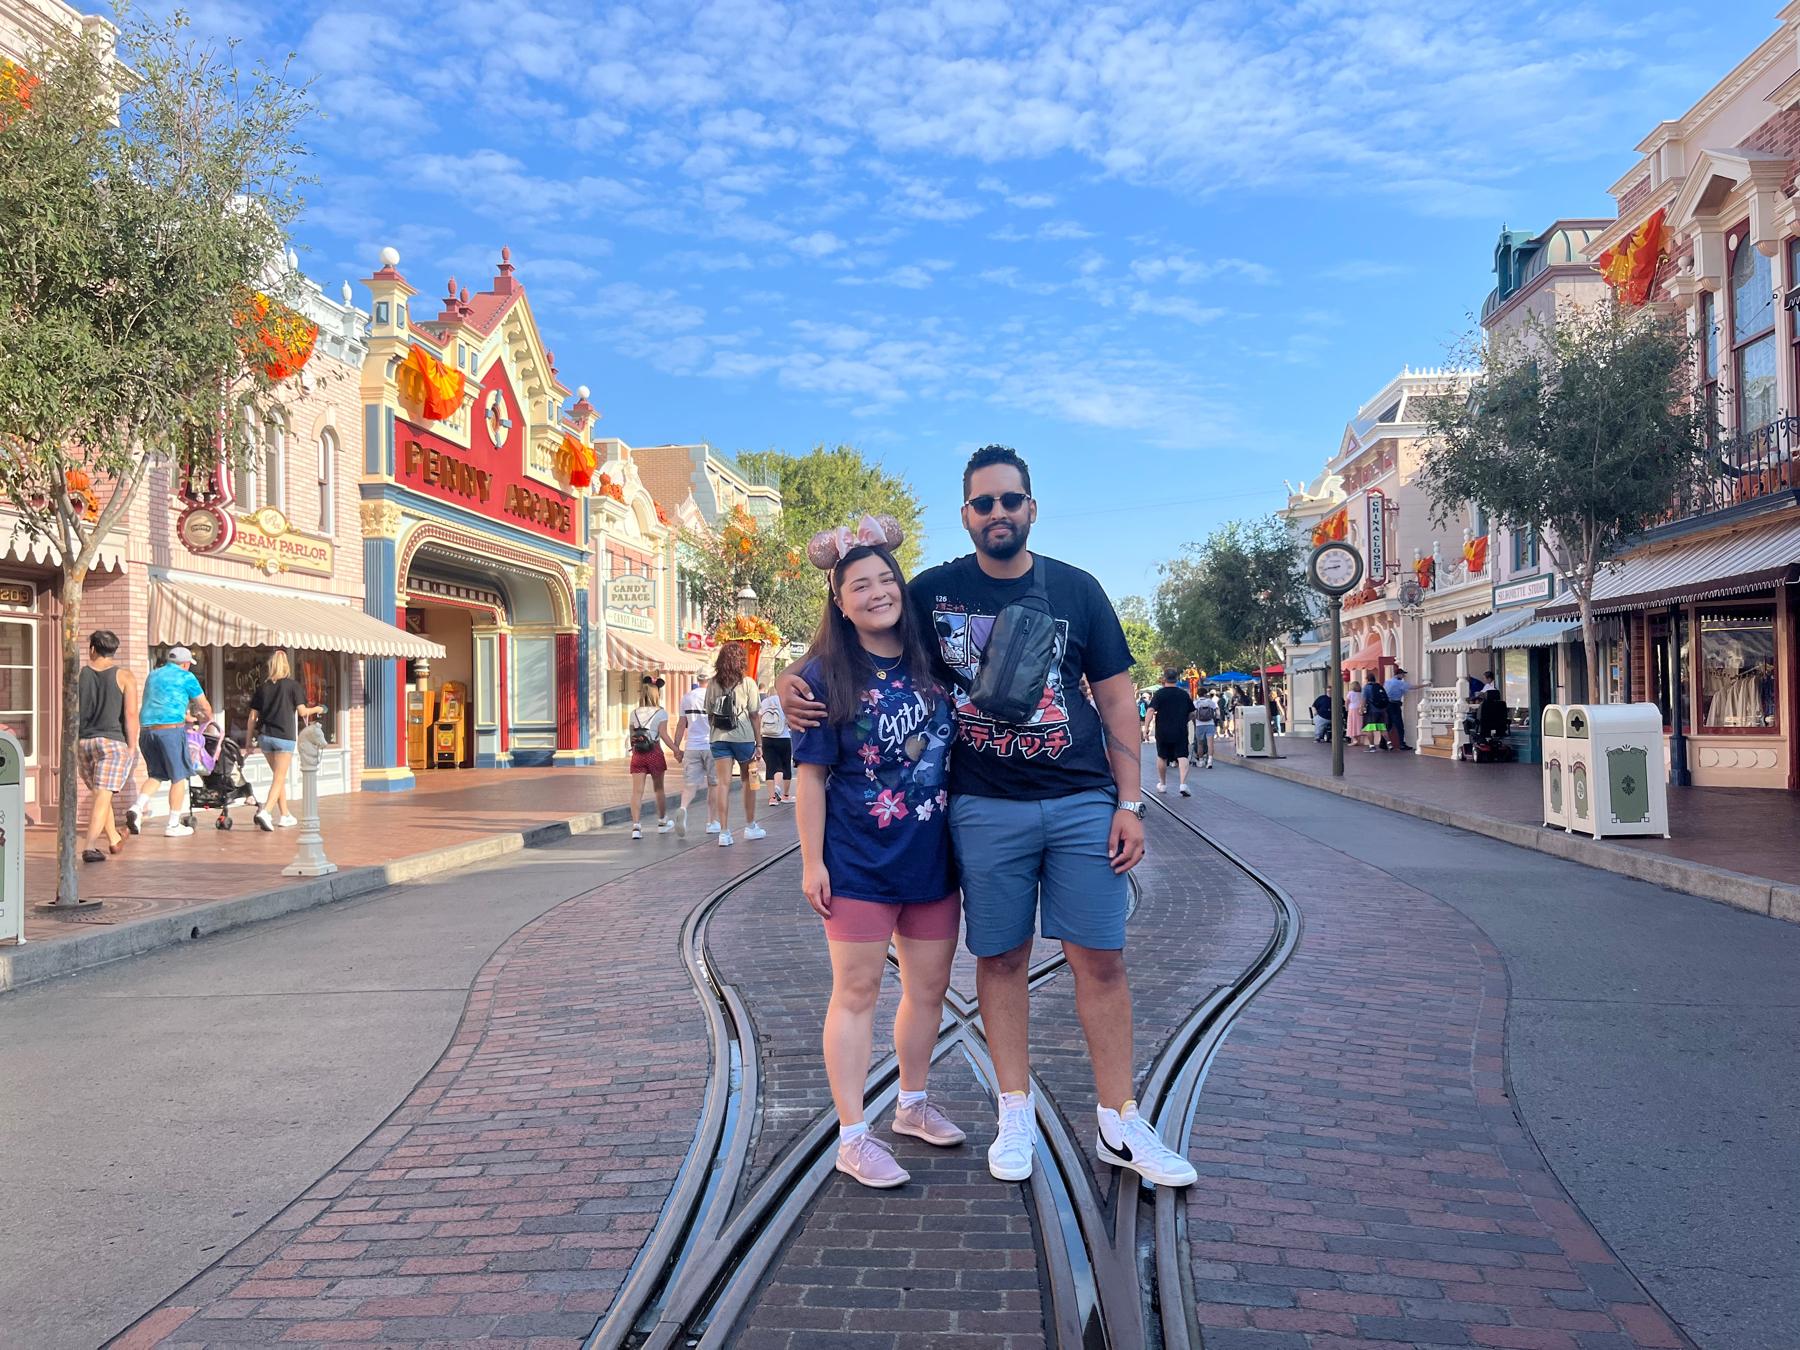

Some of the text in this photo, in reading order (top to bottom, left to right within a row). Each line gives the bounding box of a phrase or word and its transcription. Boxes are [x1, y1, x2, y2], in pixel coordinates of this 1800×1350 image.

[404, 440, 571, 534] PENNY ARCADE
[233, 530, 328, 561] REAM PARLOR
[1372, 501, 1382, 574] CHINA CLOSET
[611, 593, 650, 602] PALACE
[613, 584, 648, 593] CANDY
[613, 612, 630, 626] CANDY
